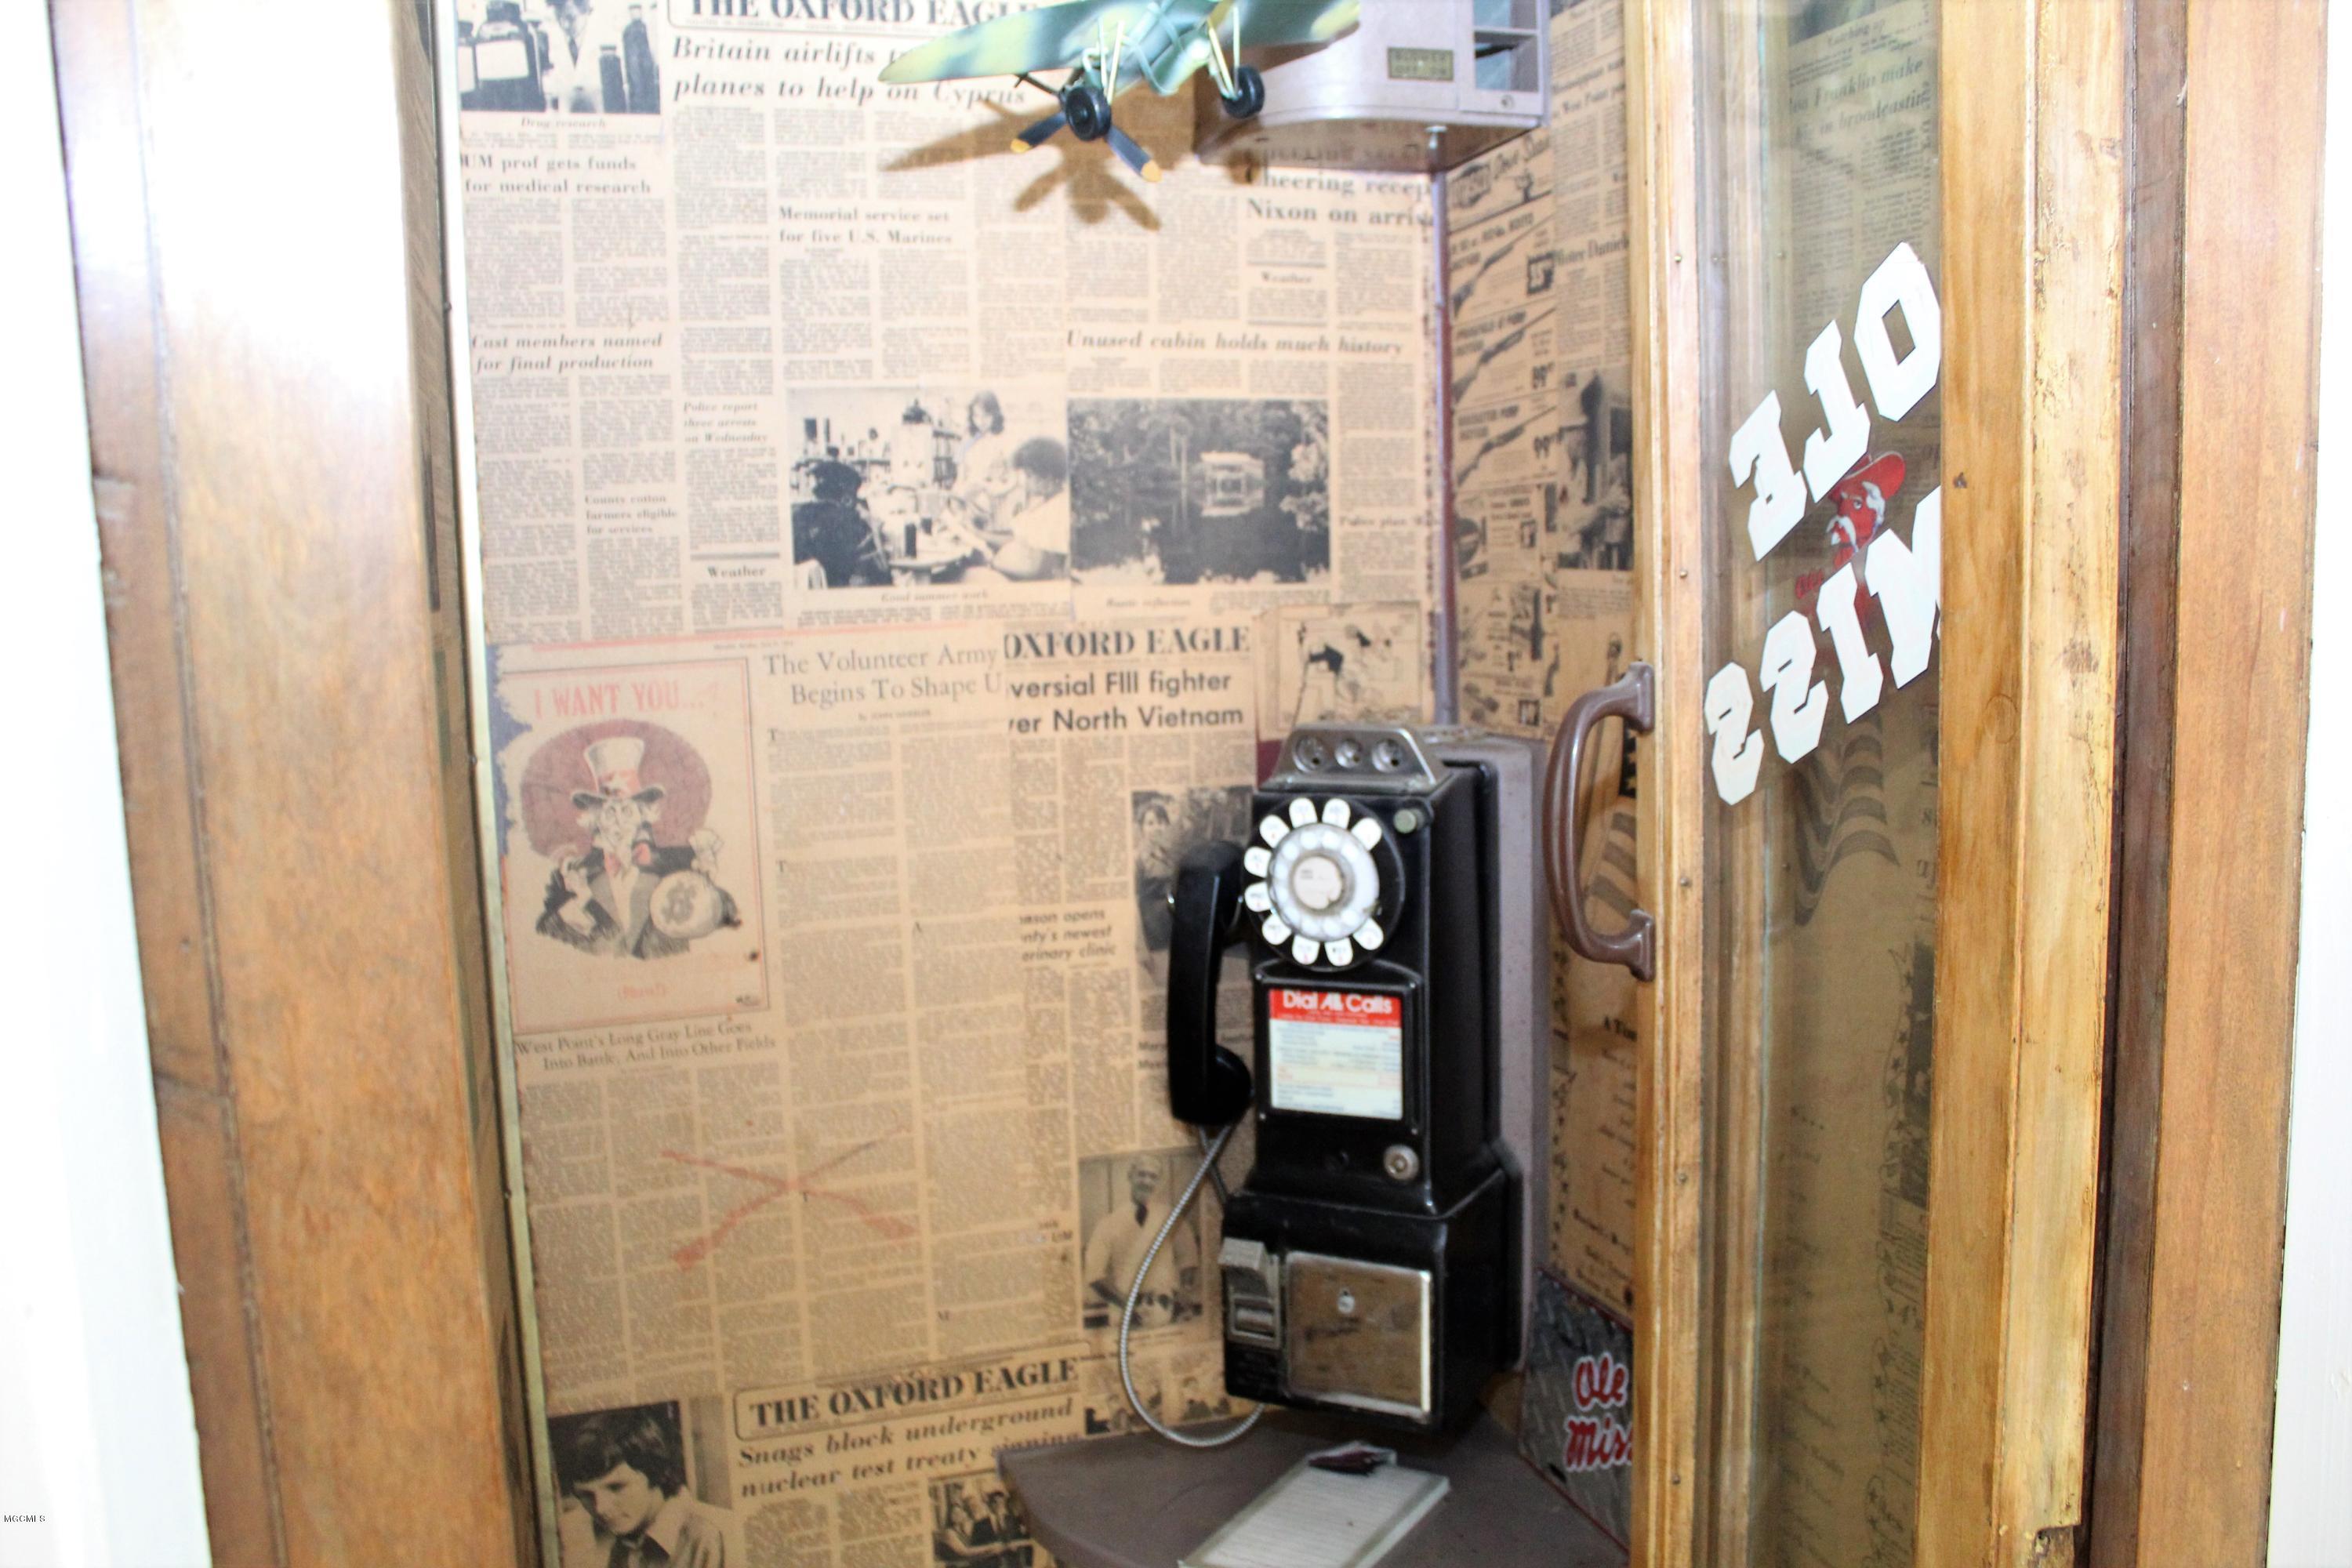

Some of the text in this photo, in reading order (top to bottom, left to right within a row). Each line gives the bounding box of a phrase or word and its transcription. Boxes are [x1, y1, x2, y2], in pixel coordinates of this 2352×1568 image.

[673, 36, 770, 61] Britain
[784, 39, 875, 71] airlifts
[673, 77, 1025, 109] planes to help on Cyprus
[555, 118, 606, 129] research
[501, 155, 540, 173] prof
[546, 158, 580, 172] gets
[588, 156, 637, 171] funds
[465, 178, 651, 194] for medical research
[779, 205, 949, 223] Memorial service set
[1247, 198, 1317, 220] Nixon
[1328, 208, 1357, 223] on
[779, 230, 953, 245] for five U.S. Marines
[1261, 270, 1312, 284] Weather
[472, 332, 663, 348] Cast members named
[1066, 330, 1403, 358] Unused cabin holds much history
[476, 355, 654, 374] for final production
[684, 401, 757, 414] Police report
[705, 432, 768, 444] Wednesday
[707, 565, 766, 579] Weather
[1147, 626, 1251, 655] EAGLE
[763, 643, 998, 676] The Volunteer Army
[791, 681, 866, 710] Begins
[872, 679, 906, 701] To
[911, 674, 978, 702] Shape
[1149, 669, 1232, 698] fighter
[534, 689, 543, 720] I
[552, 681, 622, 717] WANT
[1053, 708, 1127, 731] North
[1138, 705, 1243, 728] Vietnam
[1063, 909, 1105, 923] opens
[1063, 924, 1112, 940] newest
[1079, 941, 1116, 958] clinic
[1283, 989, 1393, 1014] Dial All Calls
[514, 1022, 752, 1054] West Point's Long Gray Line Goes
[543, 1056, 573, 1070] Into
[628, 1046, 655, 1062] And
[660, 1045, 689, 1059] Into
[691, 1040, 732, 1055] Other
[735, 1034, 776, 1051] Fields
[750, 1358, 1079, 1427] THE OXFORD EAGLE
[1572, 1351, 1628, 1411] Ole
[739, 1398, 1074, 1468] Snags block underground
[742, 1465, 842, 1497] nuclear
[851, 1455, 895, 1479] test
[906, 1445, 981, 1474] treaty
